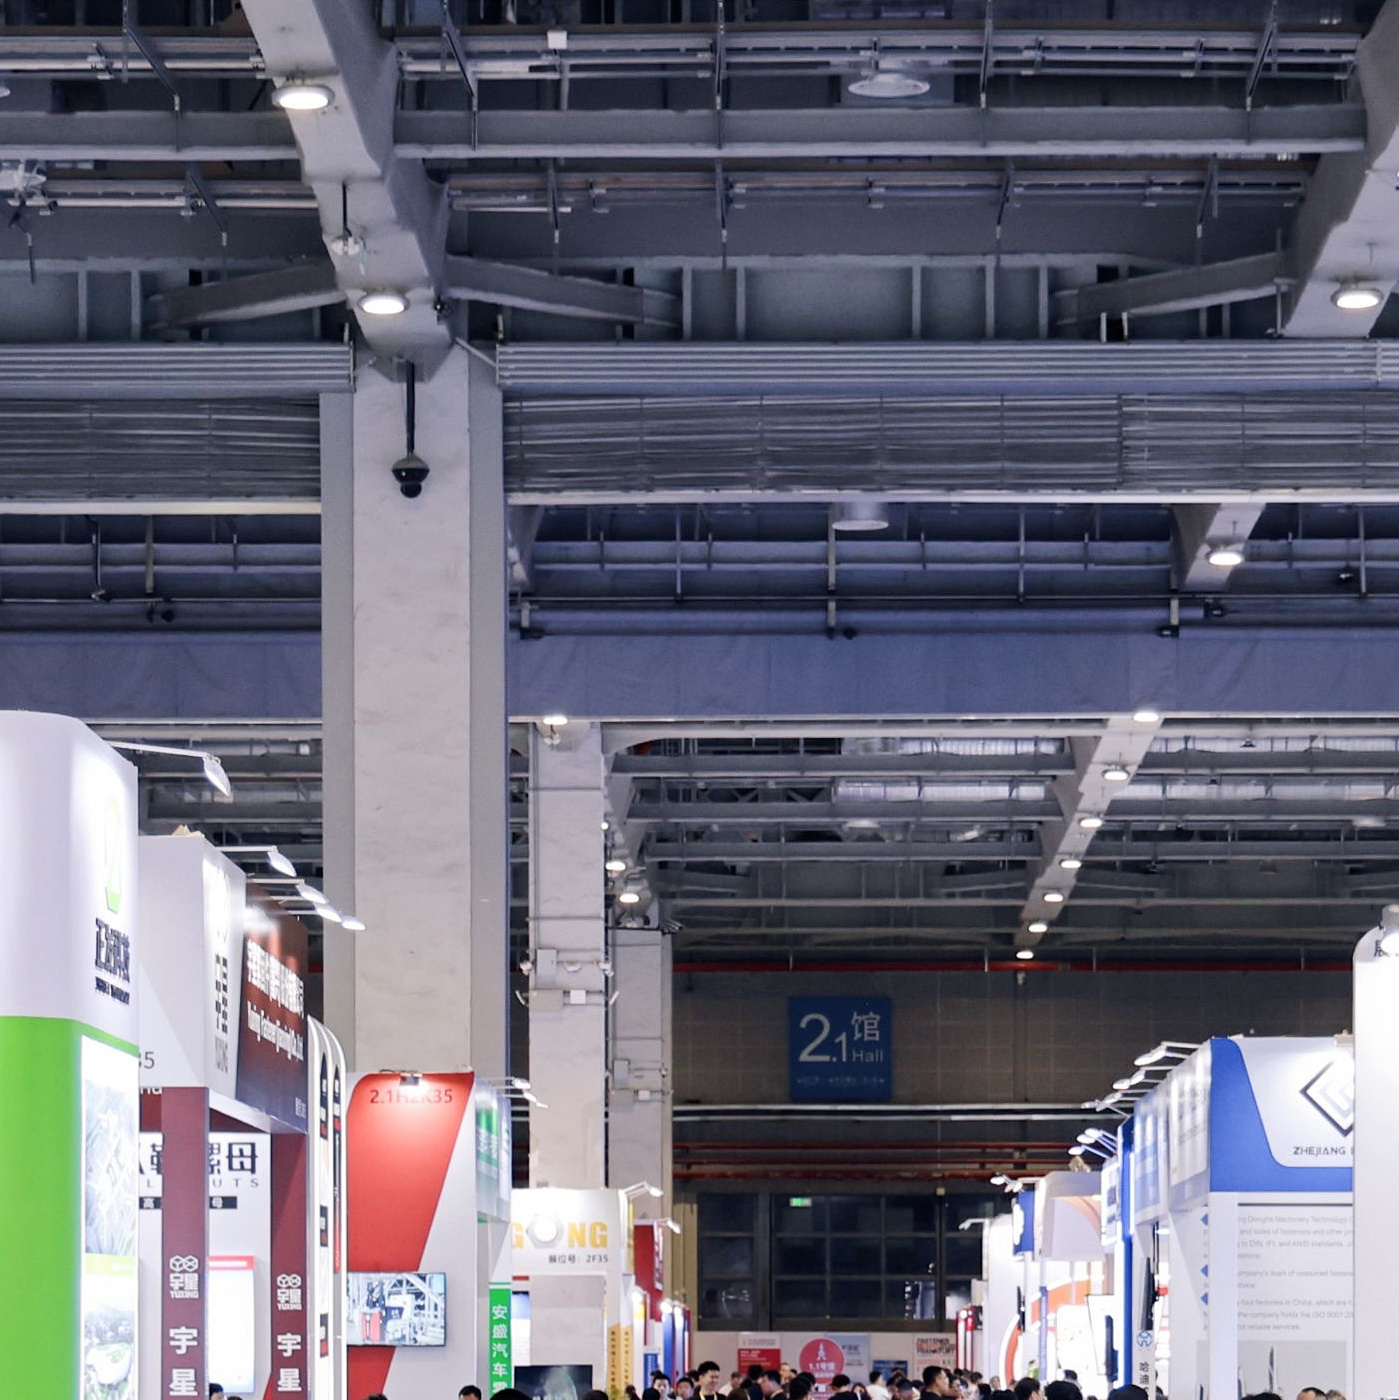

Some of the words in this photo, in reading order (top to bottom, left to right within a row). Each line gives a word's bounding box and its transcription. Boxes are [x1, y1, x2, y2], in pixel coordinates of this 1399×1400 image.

[851, 1011, 881, 1042] 馆
[852, 1049, 884, 1063] Hall
[1292, 1146, 1346, 1157] ZHEJIANG
